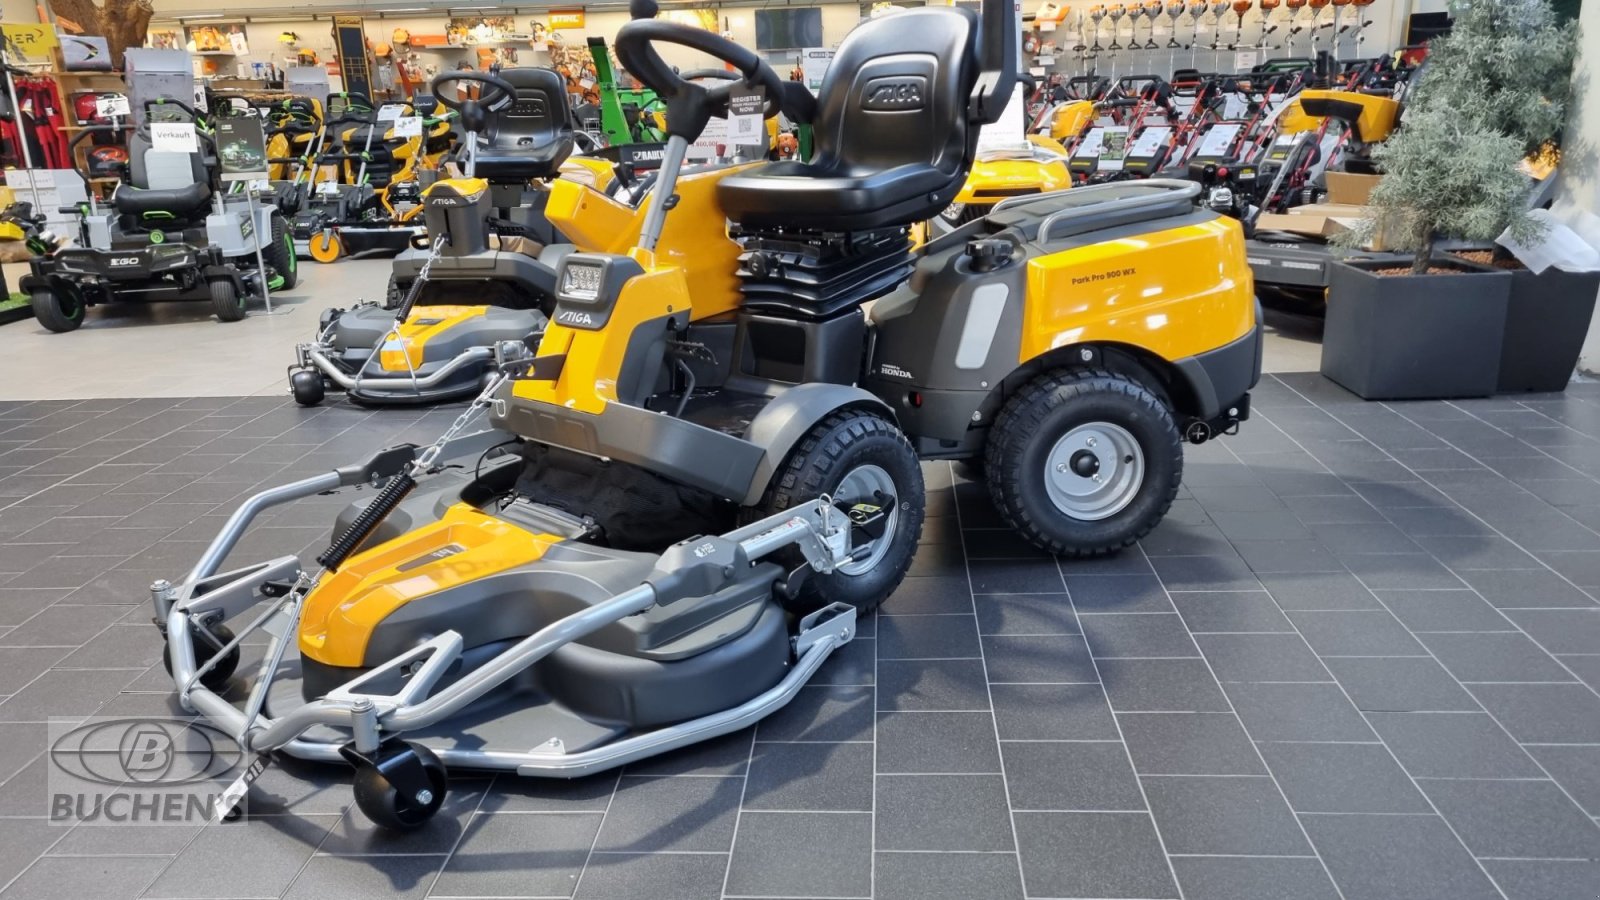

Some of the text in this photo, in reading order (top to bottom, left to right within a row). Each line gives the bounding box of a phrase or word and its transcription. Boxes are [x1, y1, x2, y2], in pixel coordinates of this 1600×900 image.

[551, 14, 579, 23] STIHL
[732, 95, 761, 103] REGISTER
[868, 84, 921, 103] STIGA
[156, 131, 190, 139] Verkauft
[362, 207, 376, 218] EGO
[110, 257, 139, 266] EGO
[1071, 276, 1091, 285] Park
[1122, 267, 1136, 276] WX
[559, 311, 592, 325] STIGA
[881, 367, 913, 379] HONDA
